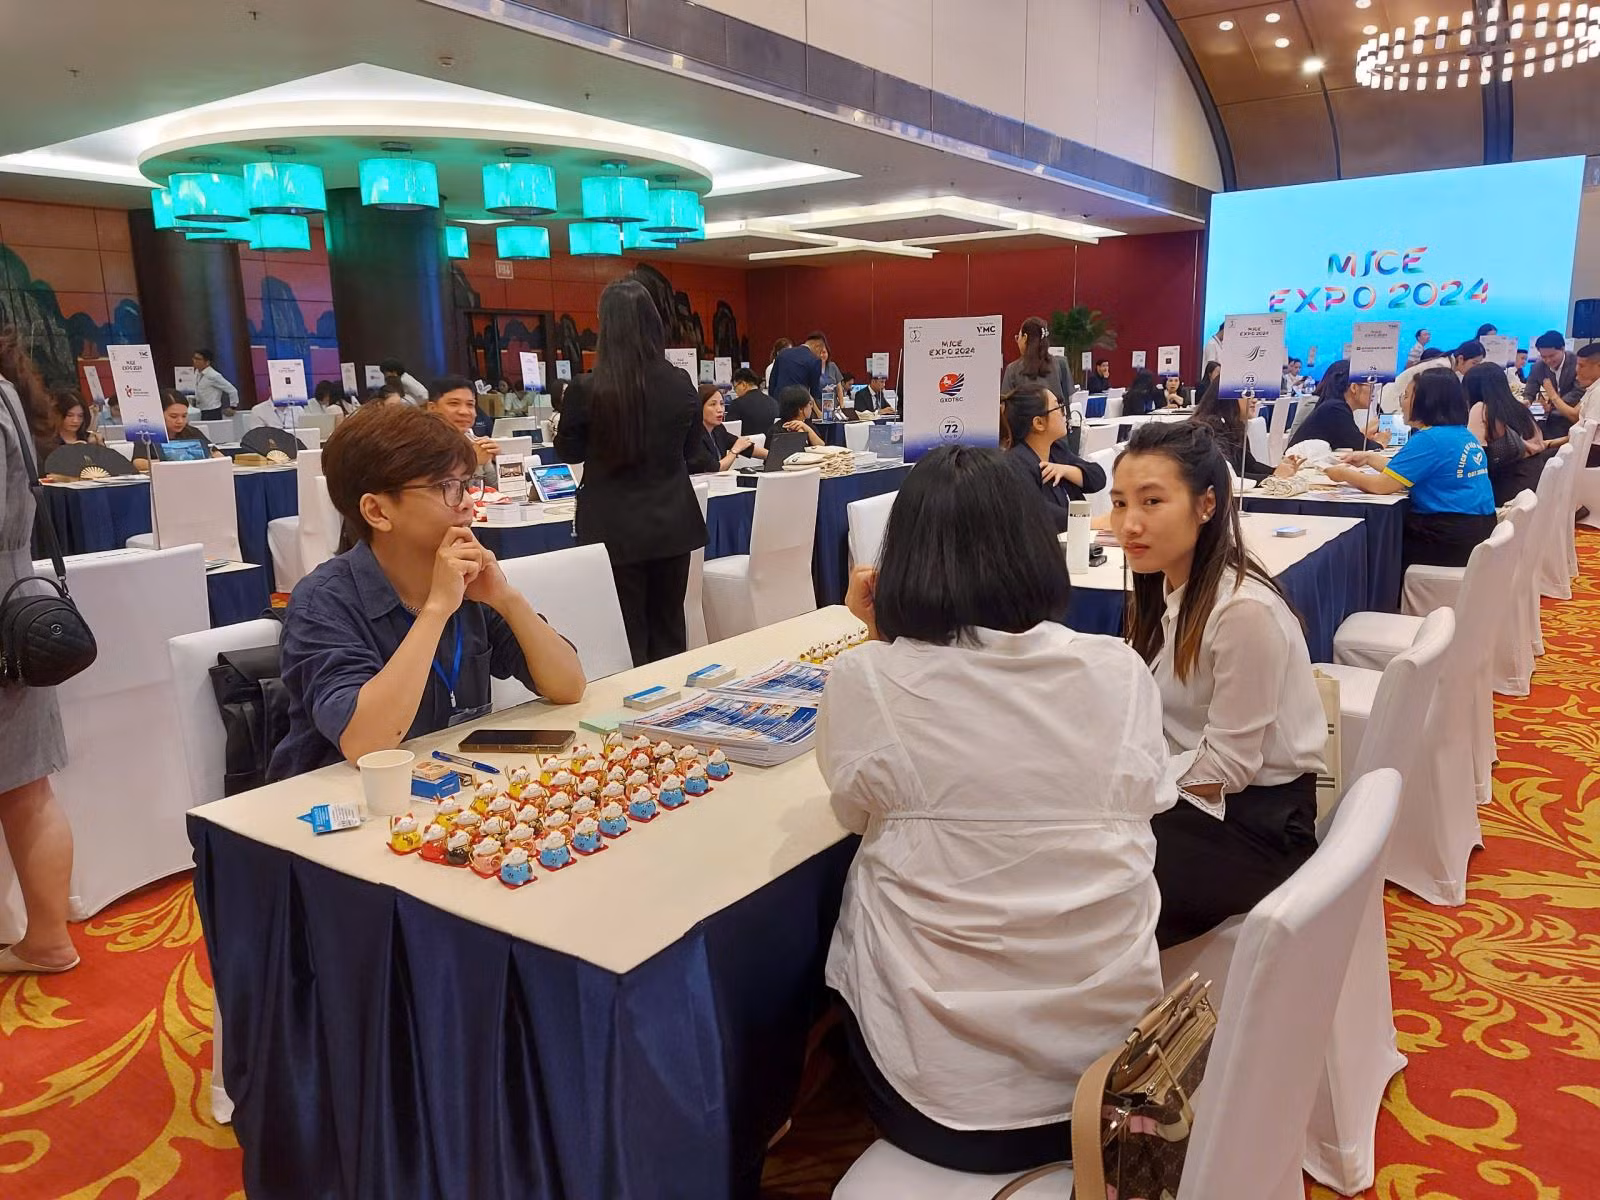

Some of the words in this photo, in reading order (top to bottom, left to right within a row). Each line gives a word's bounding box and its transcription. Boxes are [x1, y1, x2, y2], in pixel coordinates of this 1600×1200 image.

[1328, 247, 1428, 277] MICE
[1269, 286, 1377, 313] EXPO
[1388, 278, 1489, 309] 2024
[941, 340, 963, 348] MICE
[929, 348, 953, 356] EXPO
[955, 347, 975, 355] 2024
[944, 424, 959, 434] 72
